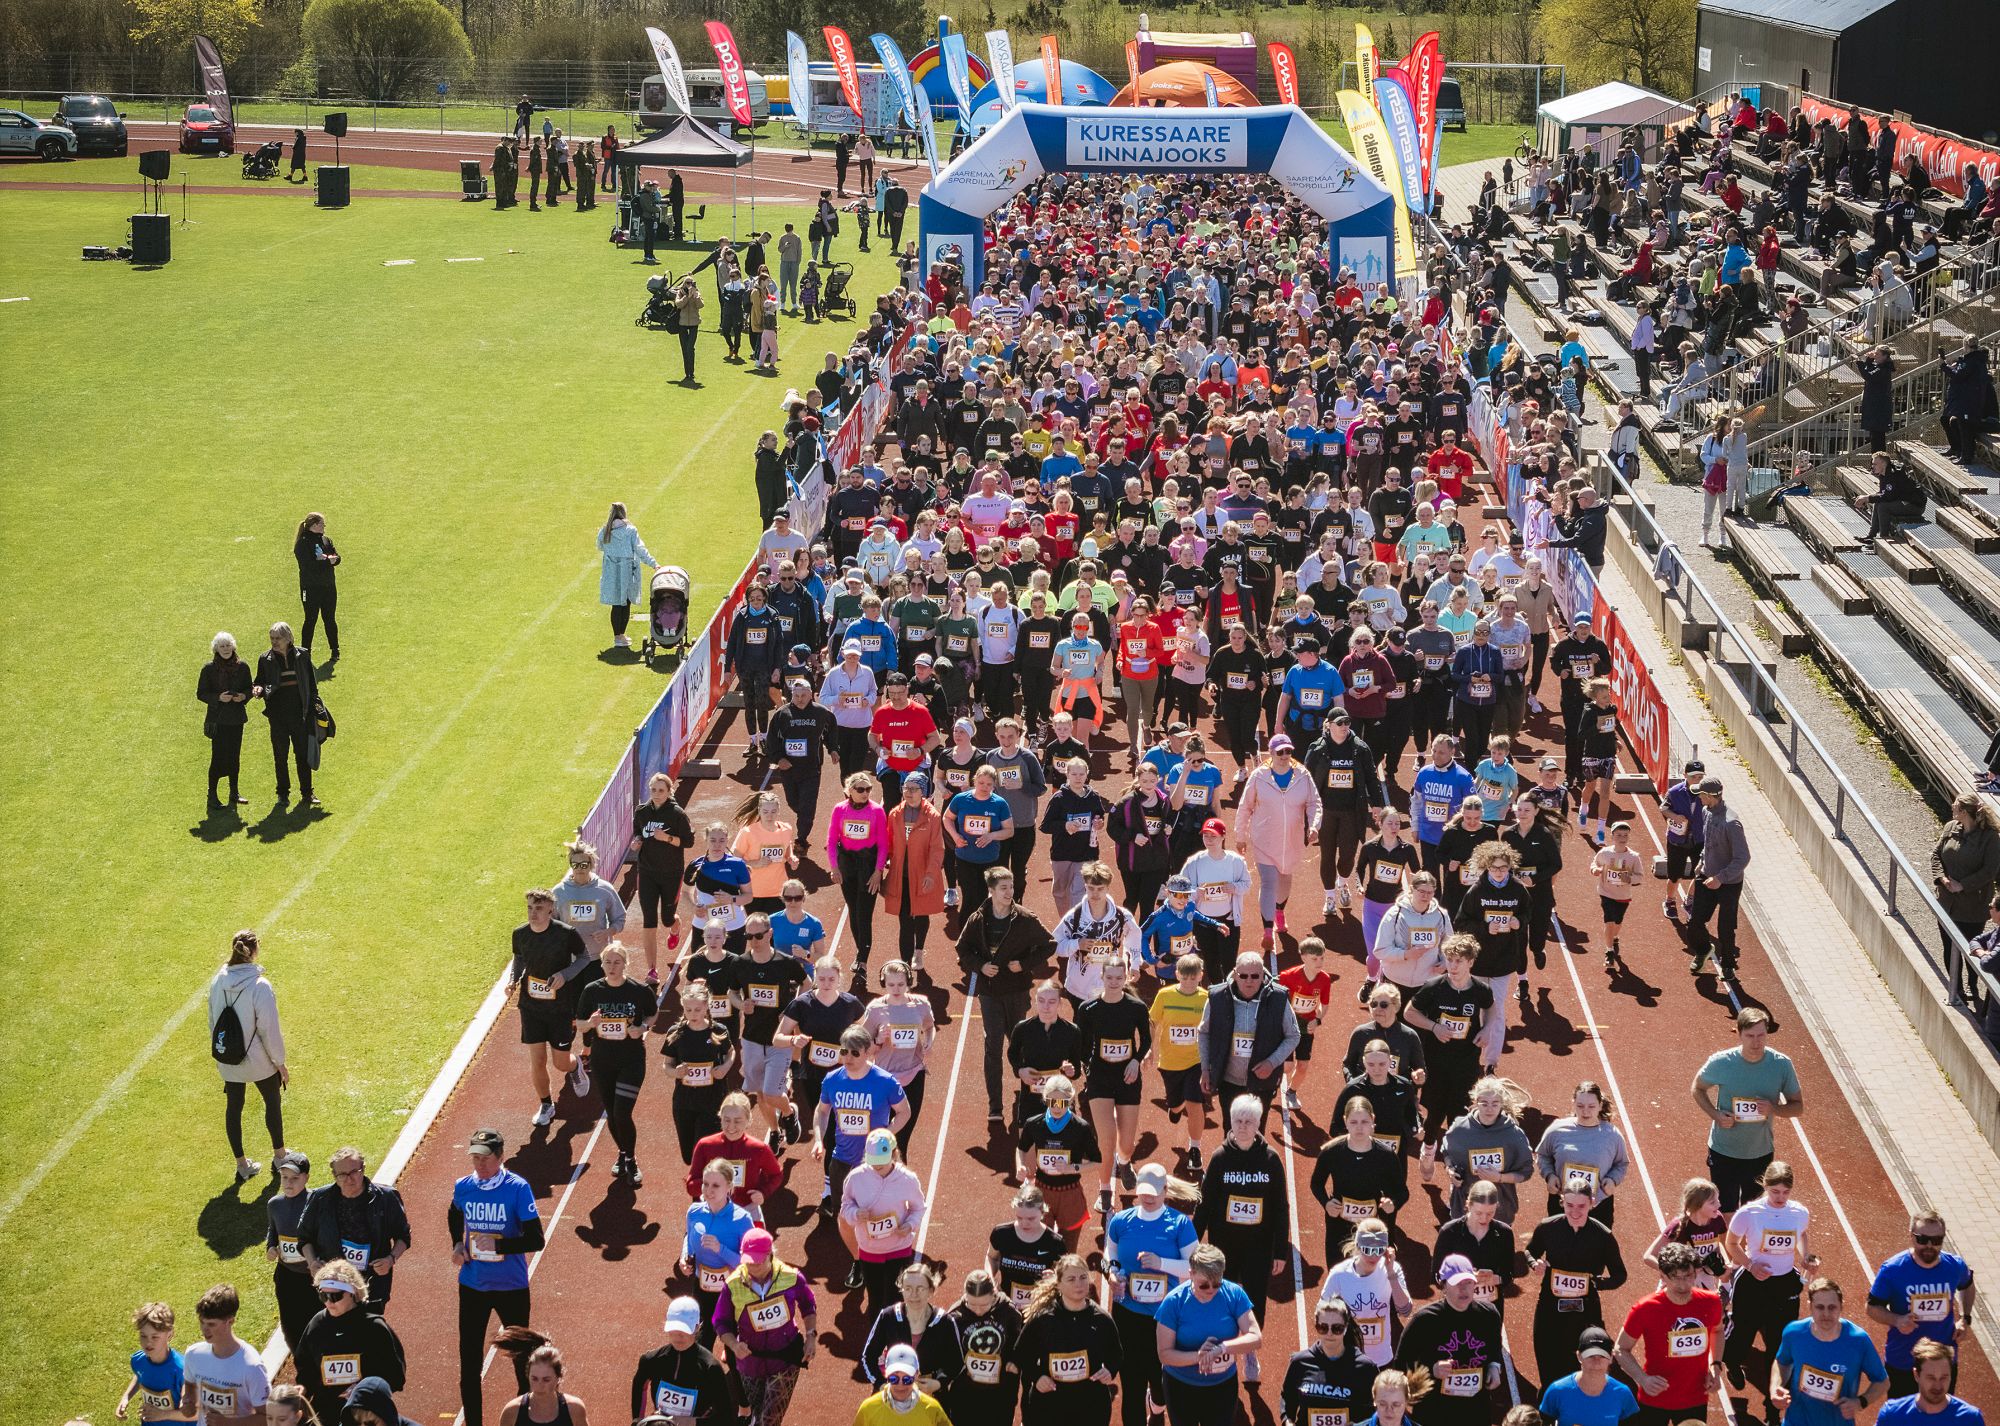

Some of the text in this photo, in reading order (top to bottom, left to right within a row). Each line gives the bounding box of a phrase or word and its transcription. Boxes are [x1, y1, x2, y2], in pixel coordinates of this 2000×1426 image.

[1080, 125, 1231, 143] KURESSAARE
[1085, 146, 1226, 162] LINNAJOOKS
[1928, 146, 1958, 182] A.LeCoq
[1060, 528, 1071, 536] 922
[1328, 528, 1343, 536] 1223
[1223, 617, 1237, 625] 582
[748, 631, 766, 639] 1183
[990, 626, 1004, 634] 838
[951, 638, 965, 646] 780
[1031, 635, 1048, 643] 1027
[1072, 652, 1087, 660] 967
[1503, 647, 1517, 655] 512
[1428, 658, 1441, 666] 837
[1576, 666, 1591, 674] 954
[1356, 675, 1371, 683] 744
[845, 696, 860, 704] 641
[1304, 692, 1319, 700] 873
[1611, 637, 1660, 763] SPORTLAND
[788, 743, 803, 751] 262
[950, 773, 965, 781] 896
[1002, 770, 1017, 779] 909
[1331, 773, 1352, 781] 1004
[1187, 789, 1204, 798] 752
[1424, 782, 1453, 797] SIGMA
[1482, 786, 1501, 796] 1117
[1427, 806, 1446, 815] 1302
[646, 822, 664, 830] NIKE
[848, 824, 865, 833] 786
[969, 820, 986, 828] 614
[760, 848, 783, 857] 1200
[1378, 865, 1397, 877] 764
[1204, 886, 1223, 895] 124
[574, 906, 592, 914] 719
[711, 907, 729, 916] 645
[1489, 915, 1508, 925] 798
[1414, 933, 1432, 942] 830
[1176, 939, 1192, 949] 478
[1092, 946, 1111, 955] 024
[754, 990, 773, 999] 363
[710, 1000, 726, 1009] 34
[1295, 998, 1317, 1007] 1175
[602, 1024, 622, 1032] 538
[1171, 1028, 1196, 1038] 1291
[894, 1030, 914, 1040] 672
[1103, 1044, 1129, 1054] 1217
[1236, 1039, 1254, 1049] 127
[816, 1047, 836, 1059] 650
[834, 1092, 872, 1110] SIGMA
[844, 1116, 864, 1126] 489
[1043, 1156, 1064, 1166] 59
[1472, 1154, 1502, 1166] 1243
[465, 1201, 507, 1222] SIGMA
[1233, 1204, 1256, 1215] 543
[1344, 1204, 1374, 1215] 1267
[489, 1223, 506, 1231] GROUP
[871, 1219, 893, 1231] 773
[1768, 1236, 1792, 1246] 699
[283, 1243, 296, 1254] 66
[342, 1249, 363, 1261] 266
[704, 1273, 725, 1283] 794
[1554, 1275, 1585, 1290] 1405
[1136, 1281, 1160, 1292] 747
[1016, 1291, 1032, 1300] 54
[1918, 1300, 1943, 1311] 427
[757, 1306, 781, 1321] 469
[1361, 1325, 1376, 1335] 31
[1676, 1335, 1702, 1348] 636
[328, 1362, 353, 1374] 470
[970, 1360, 996, 1372] 657
[1052, 1358, 1086, 1372] 1022
[1446, 1375, 1479, 1388] 1329
[1807, 1375, 1834, 1390] 393
[1301, 1382, 1352, 1398] #INCAP
[143, 1396, 170, 1408] 1450
[202, 1390, 232, 1406] 1451
[662, 1390, 688, 1407] 251
[1316, 1415, 1342, 1426] 588
